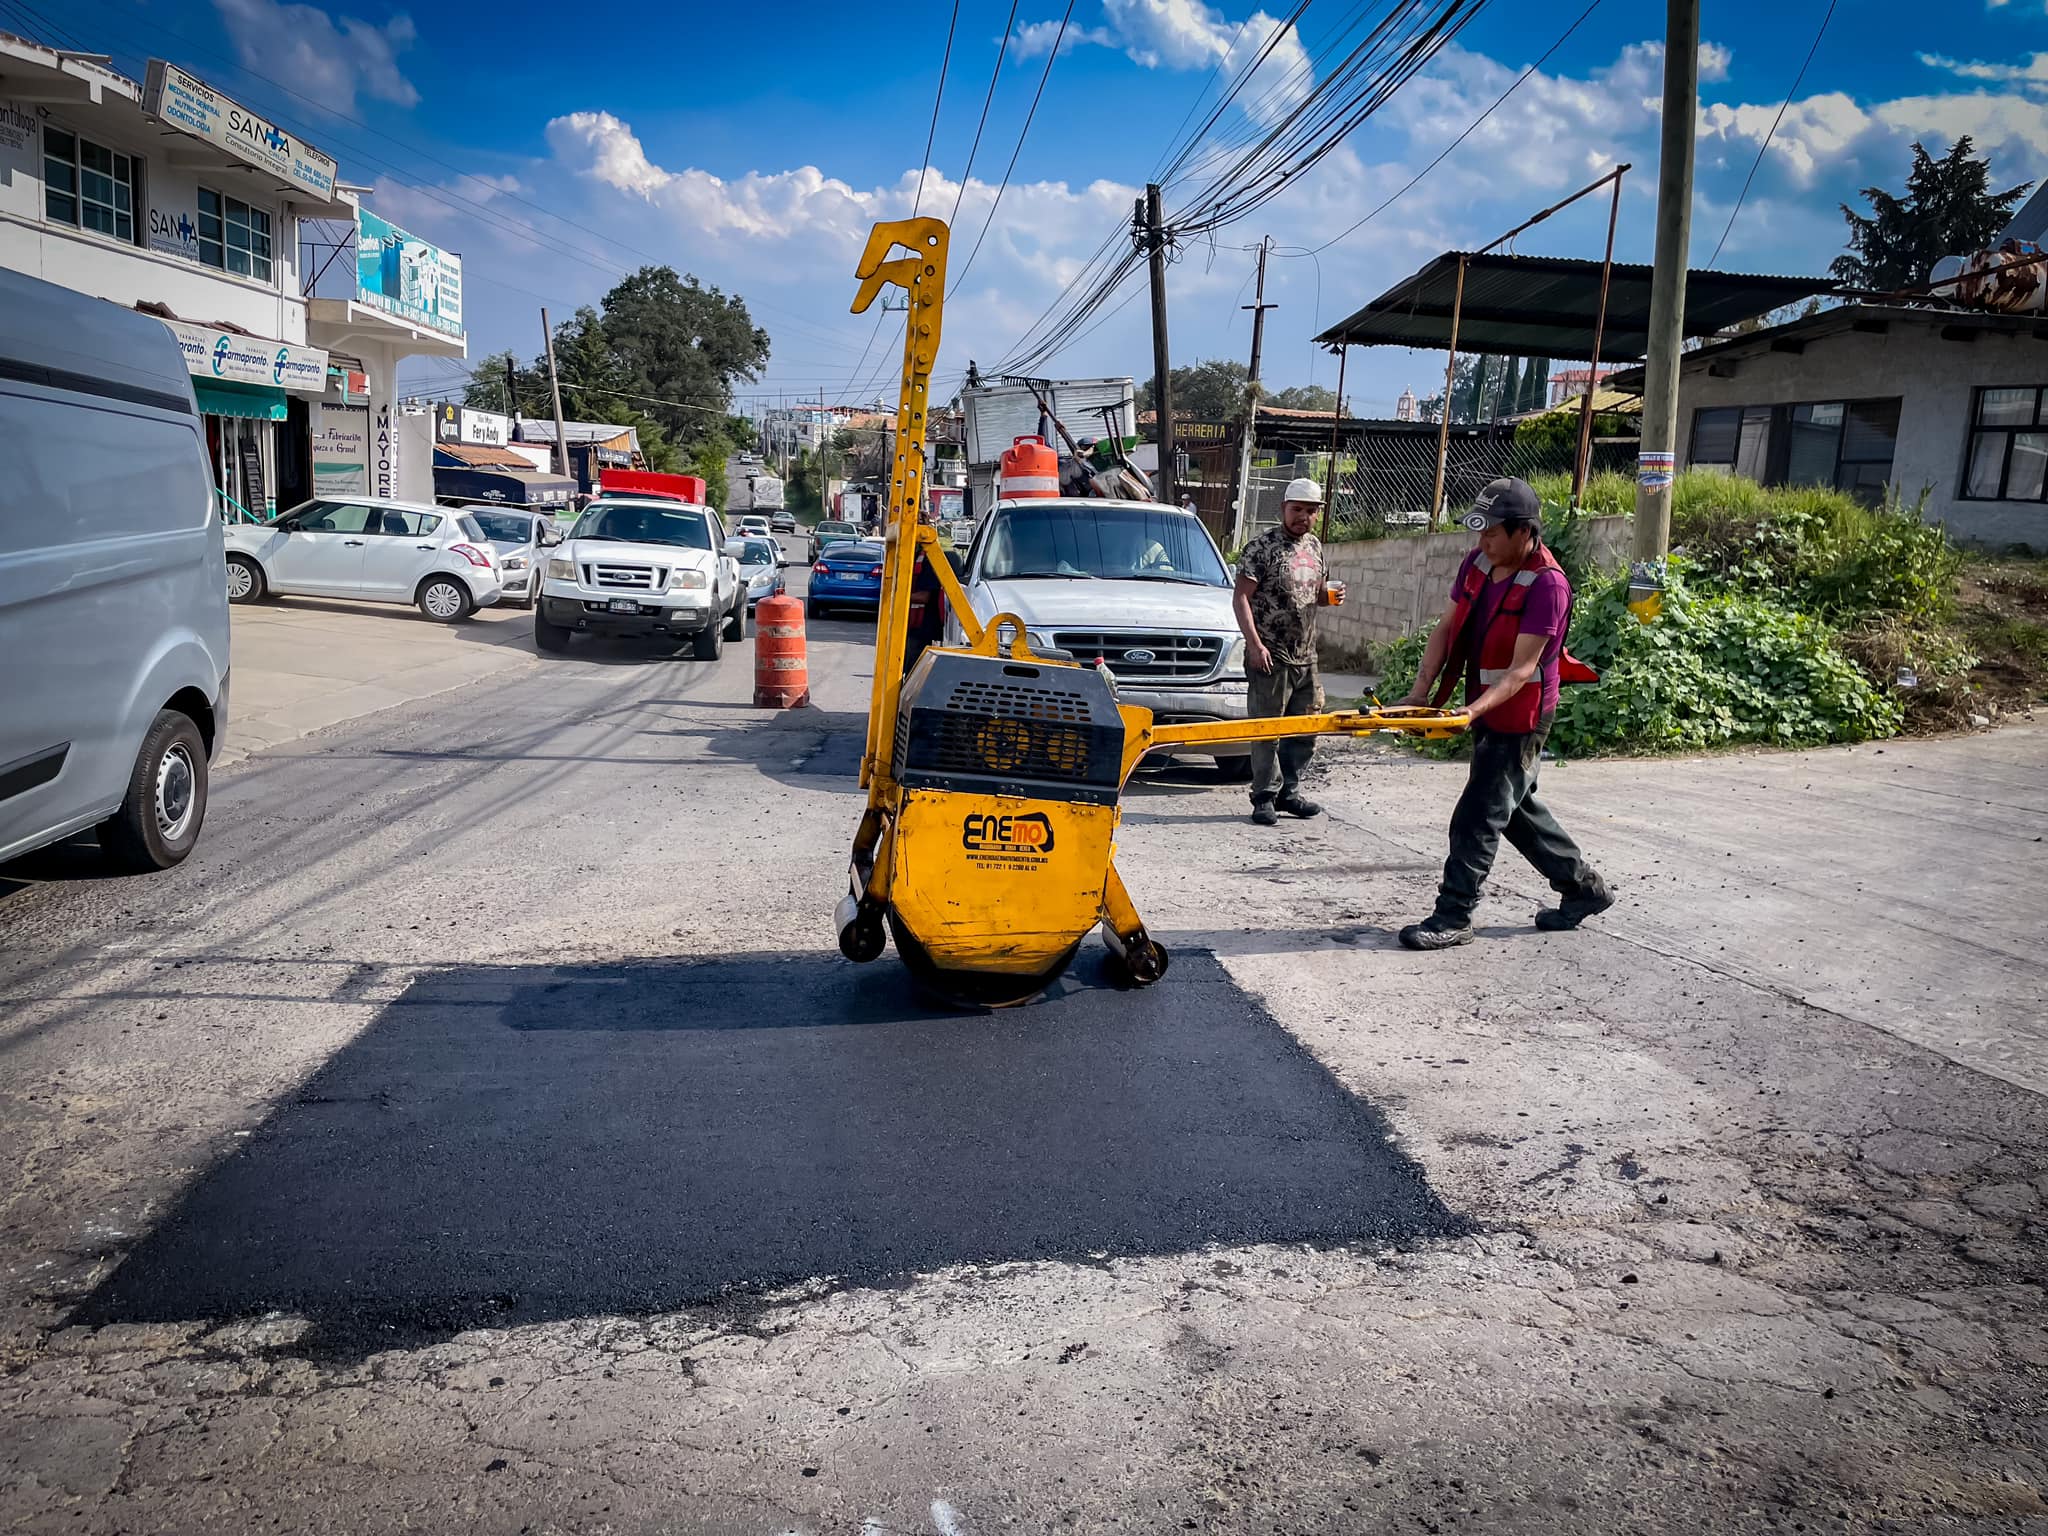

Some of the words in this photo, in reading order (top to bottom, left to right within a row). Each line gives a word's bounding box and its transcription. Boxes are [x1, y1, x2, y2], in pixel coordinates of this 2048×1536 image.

[168, 83, 195, 103] MEDICINA
[196, 99, 220, 118] GENERAL
[177, 75, 214, 102] SERVICIOS
[166, 105, 211, 134] ODONTOLOGIA
[225, 135, 263, 162] Consultorio
[264, 156, 288, 175] Integral
[304, 147, 330, 167] TELEFONOS
[472, 423, 482, 440] Fer
[486, 426, 499, 445] Andy
[1175, 423, 1226, 439] HERRERIA
[1130, 652, 1149, 661] Ford
